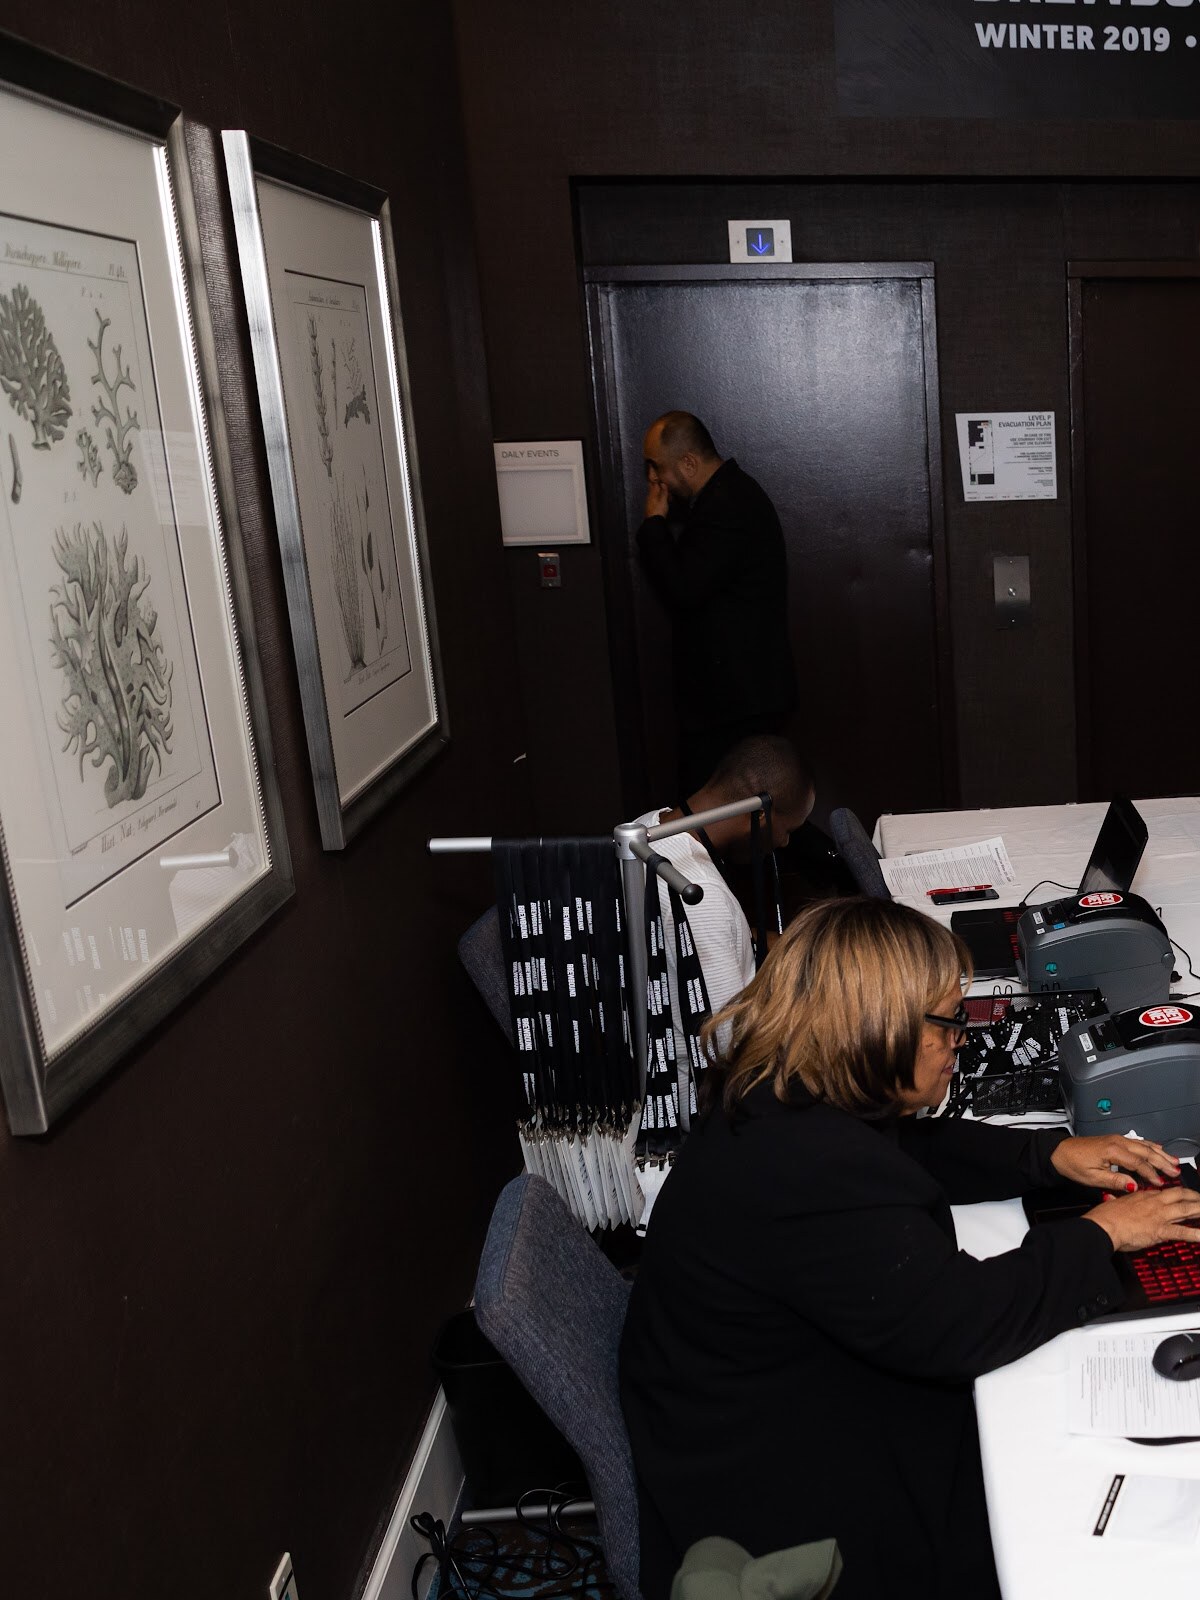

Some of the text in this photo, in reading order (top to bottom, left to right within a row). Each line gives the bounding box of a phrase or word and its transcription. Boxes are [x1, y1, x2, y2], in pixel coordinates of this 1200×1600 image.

[974, 22, 1096, 50] WINTER
[1103, 26, 1171, 52] 2019
[501, 449, 559, 459] DAILY EVENTS
